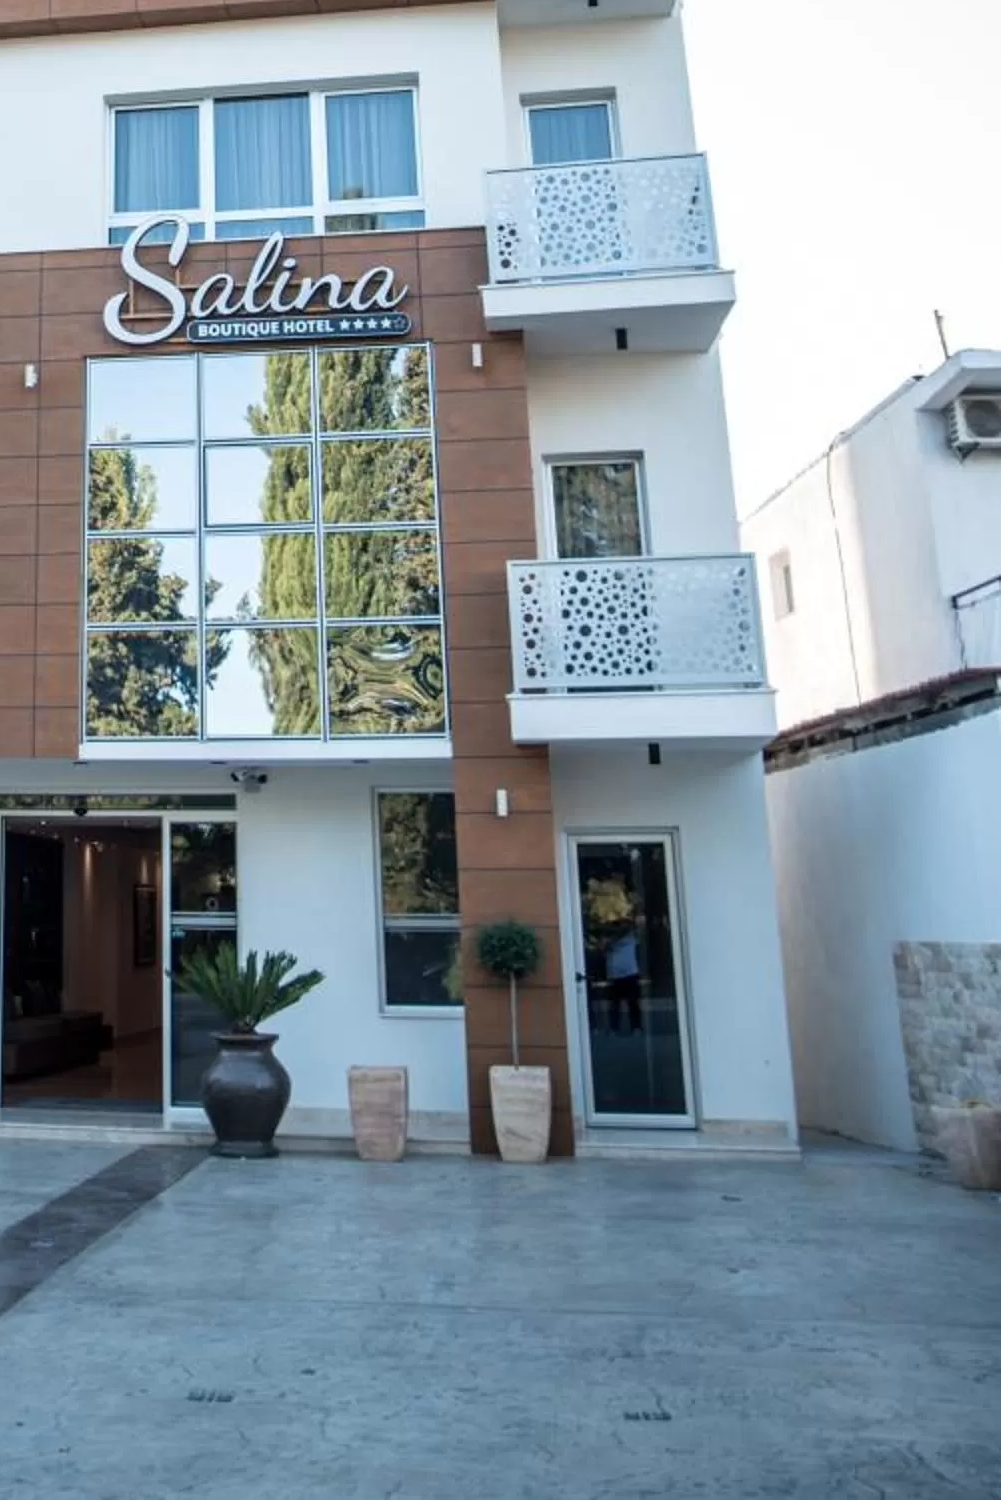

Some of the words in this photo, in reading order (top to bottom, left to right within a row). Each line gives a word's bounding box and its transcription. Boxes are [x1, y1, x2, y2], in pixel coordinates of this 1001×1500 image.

[104, 214, 409, 344] Salina
[198, 321, 280, 338] BOUTIQUE
[283, 318, 334, 334] HOTEL
